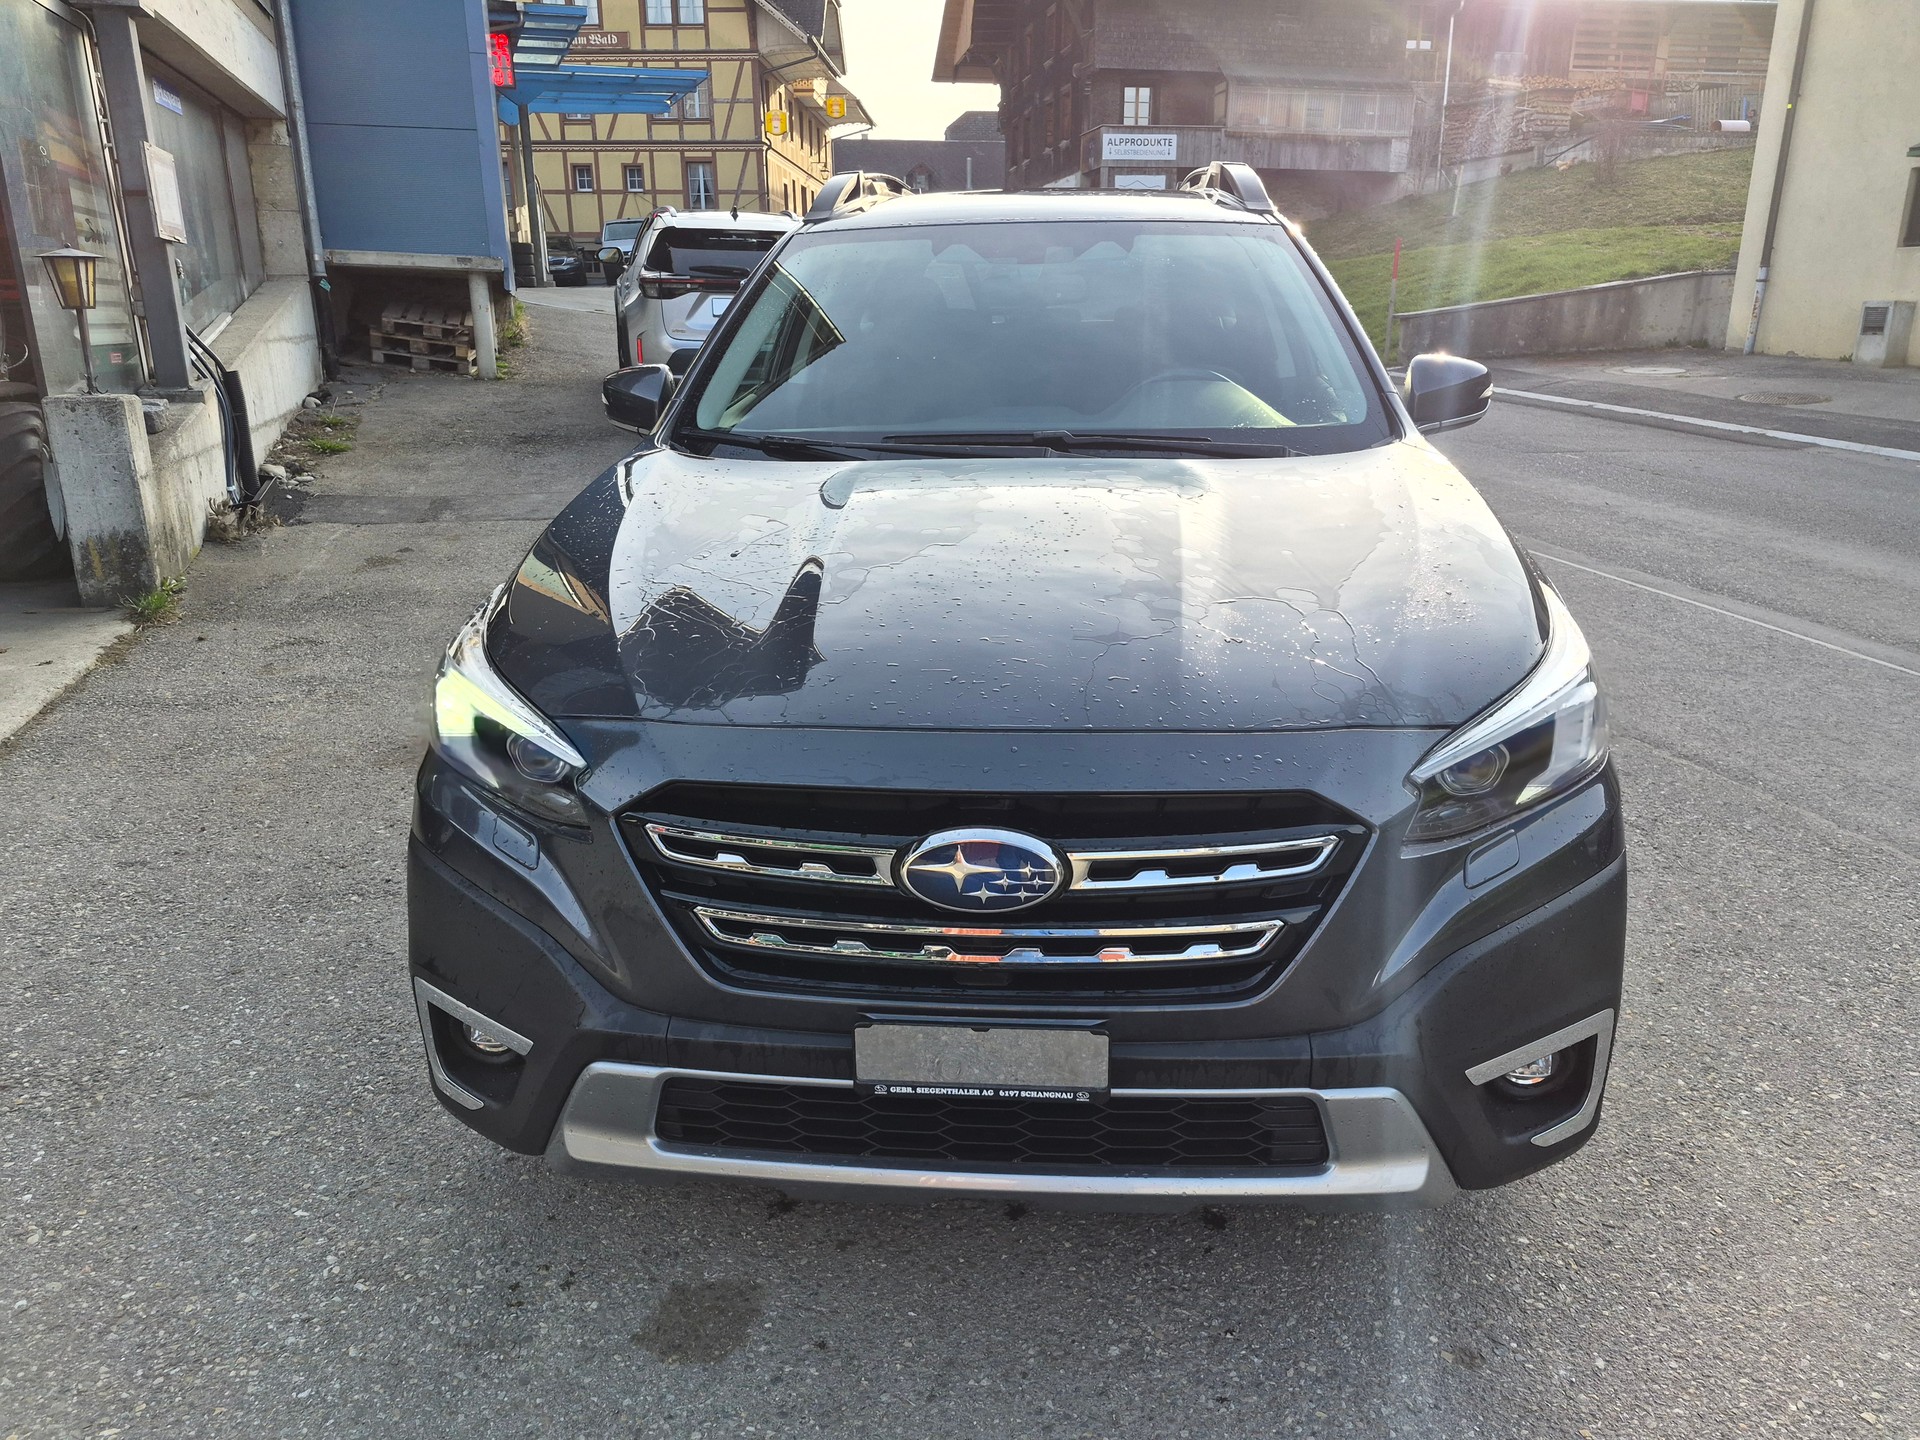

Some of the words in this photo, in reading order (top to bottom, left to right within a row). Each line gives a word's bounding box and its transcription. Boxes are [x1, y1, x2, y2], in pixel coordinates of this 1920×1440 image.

[588, 33, 618, 45] Wald
[1107, 138, 1173, 147] ALPPRODUKTE
[1113, 148, 1166, 156] SELBSTBEDIENUNG
[890, 1086, 915, 1094] GEBR.
[916, 1087, 980, 1096] SIEGENTHALER
[999, 1089, 1020, 1097] 6197
[1020, 1091, 1074, 1099] SCHANGNAU
